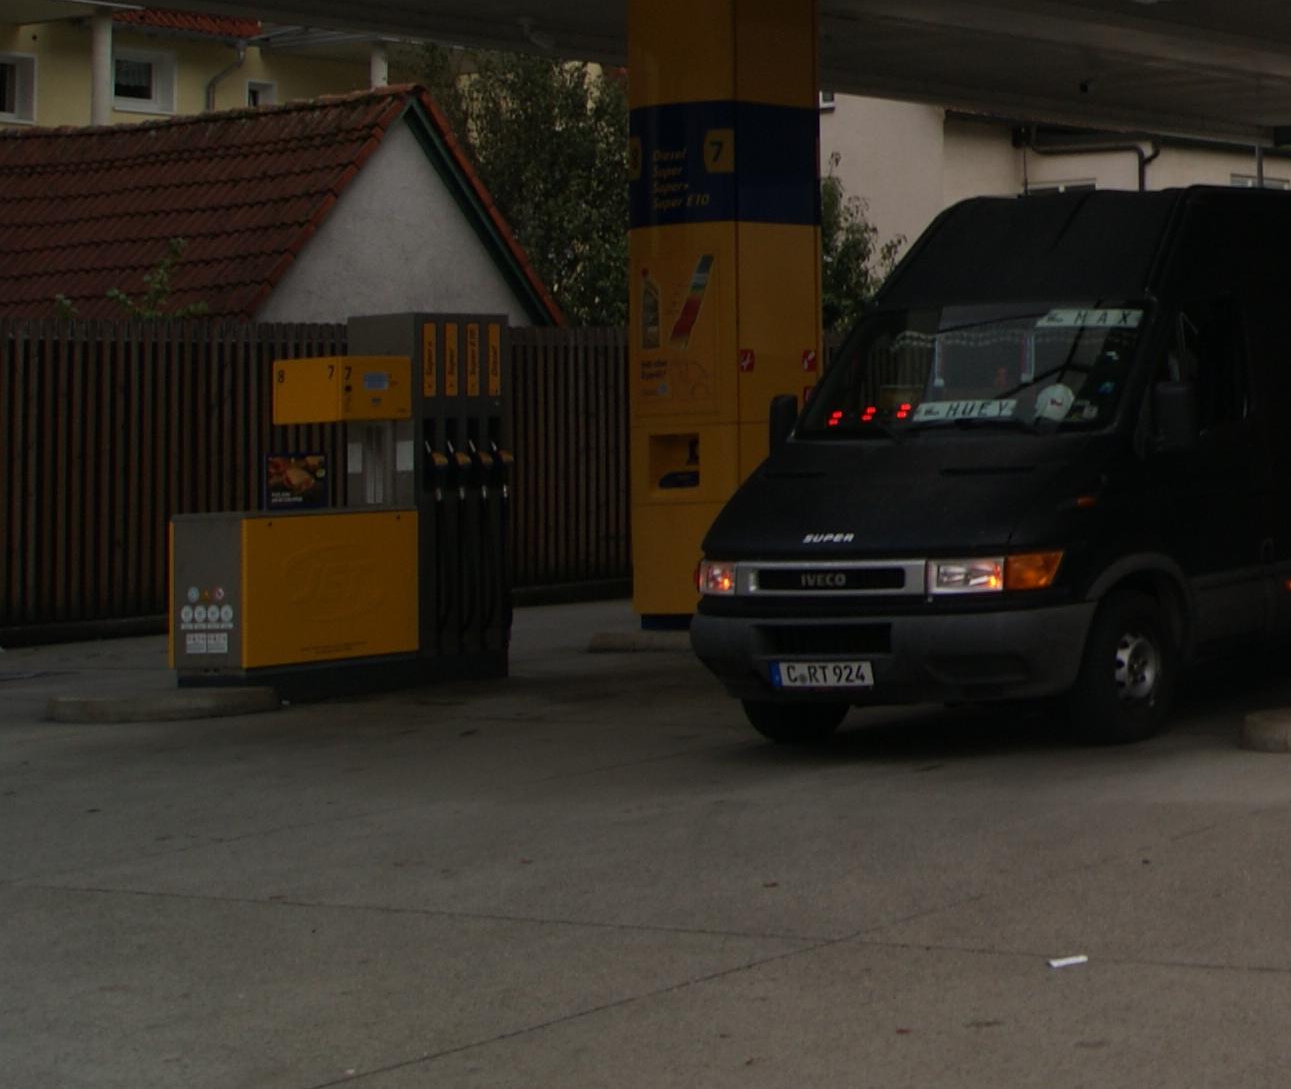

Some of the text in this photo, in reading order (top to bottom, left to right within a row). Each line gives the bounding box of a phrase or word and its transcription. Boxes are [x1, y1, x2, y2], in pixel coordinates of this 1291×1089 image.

[709, 140, 724, 163] 7
[277, 369, 286, 384] 8
[327, 364, 335, 380] 7
[344, 366, 353, 381] 7
[802, 532, 856, 544] SUPER
[801, 573, 847, 587] IVECO
[833, 665, 866, 683] 924
